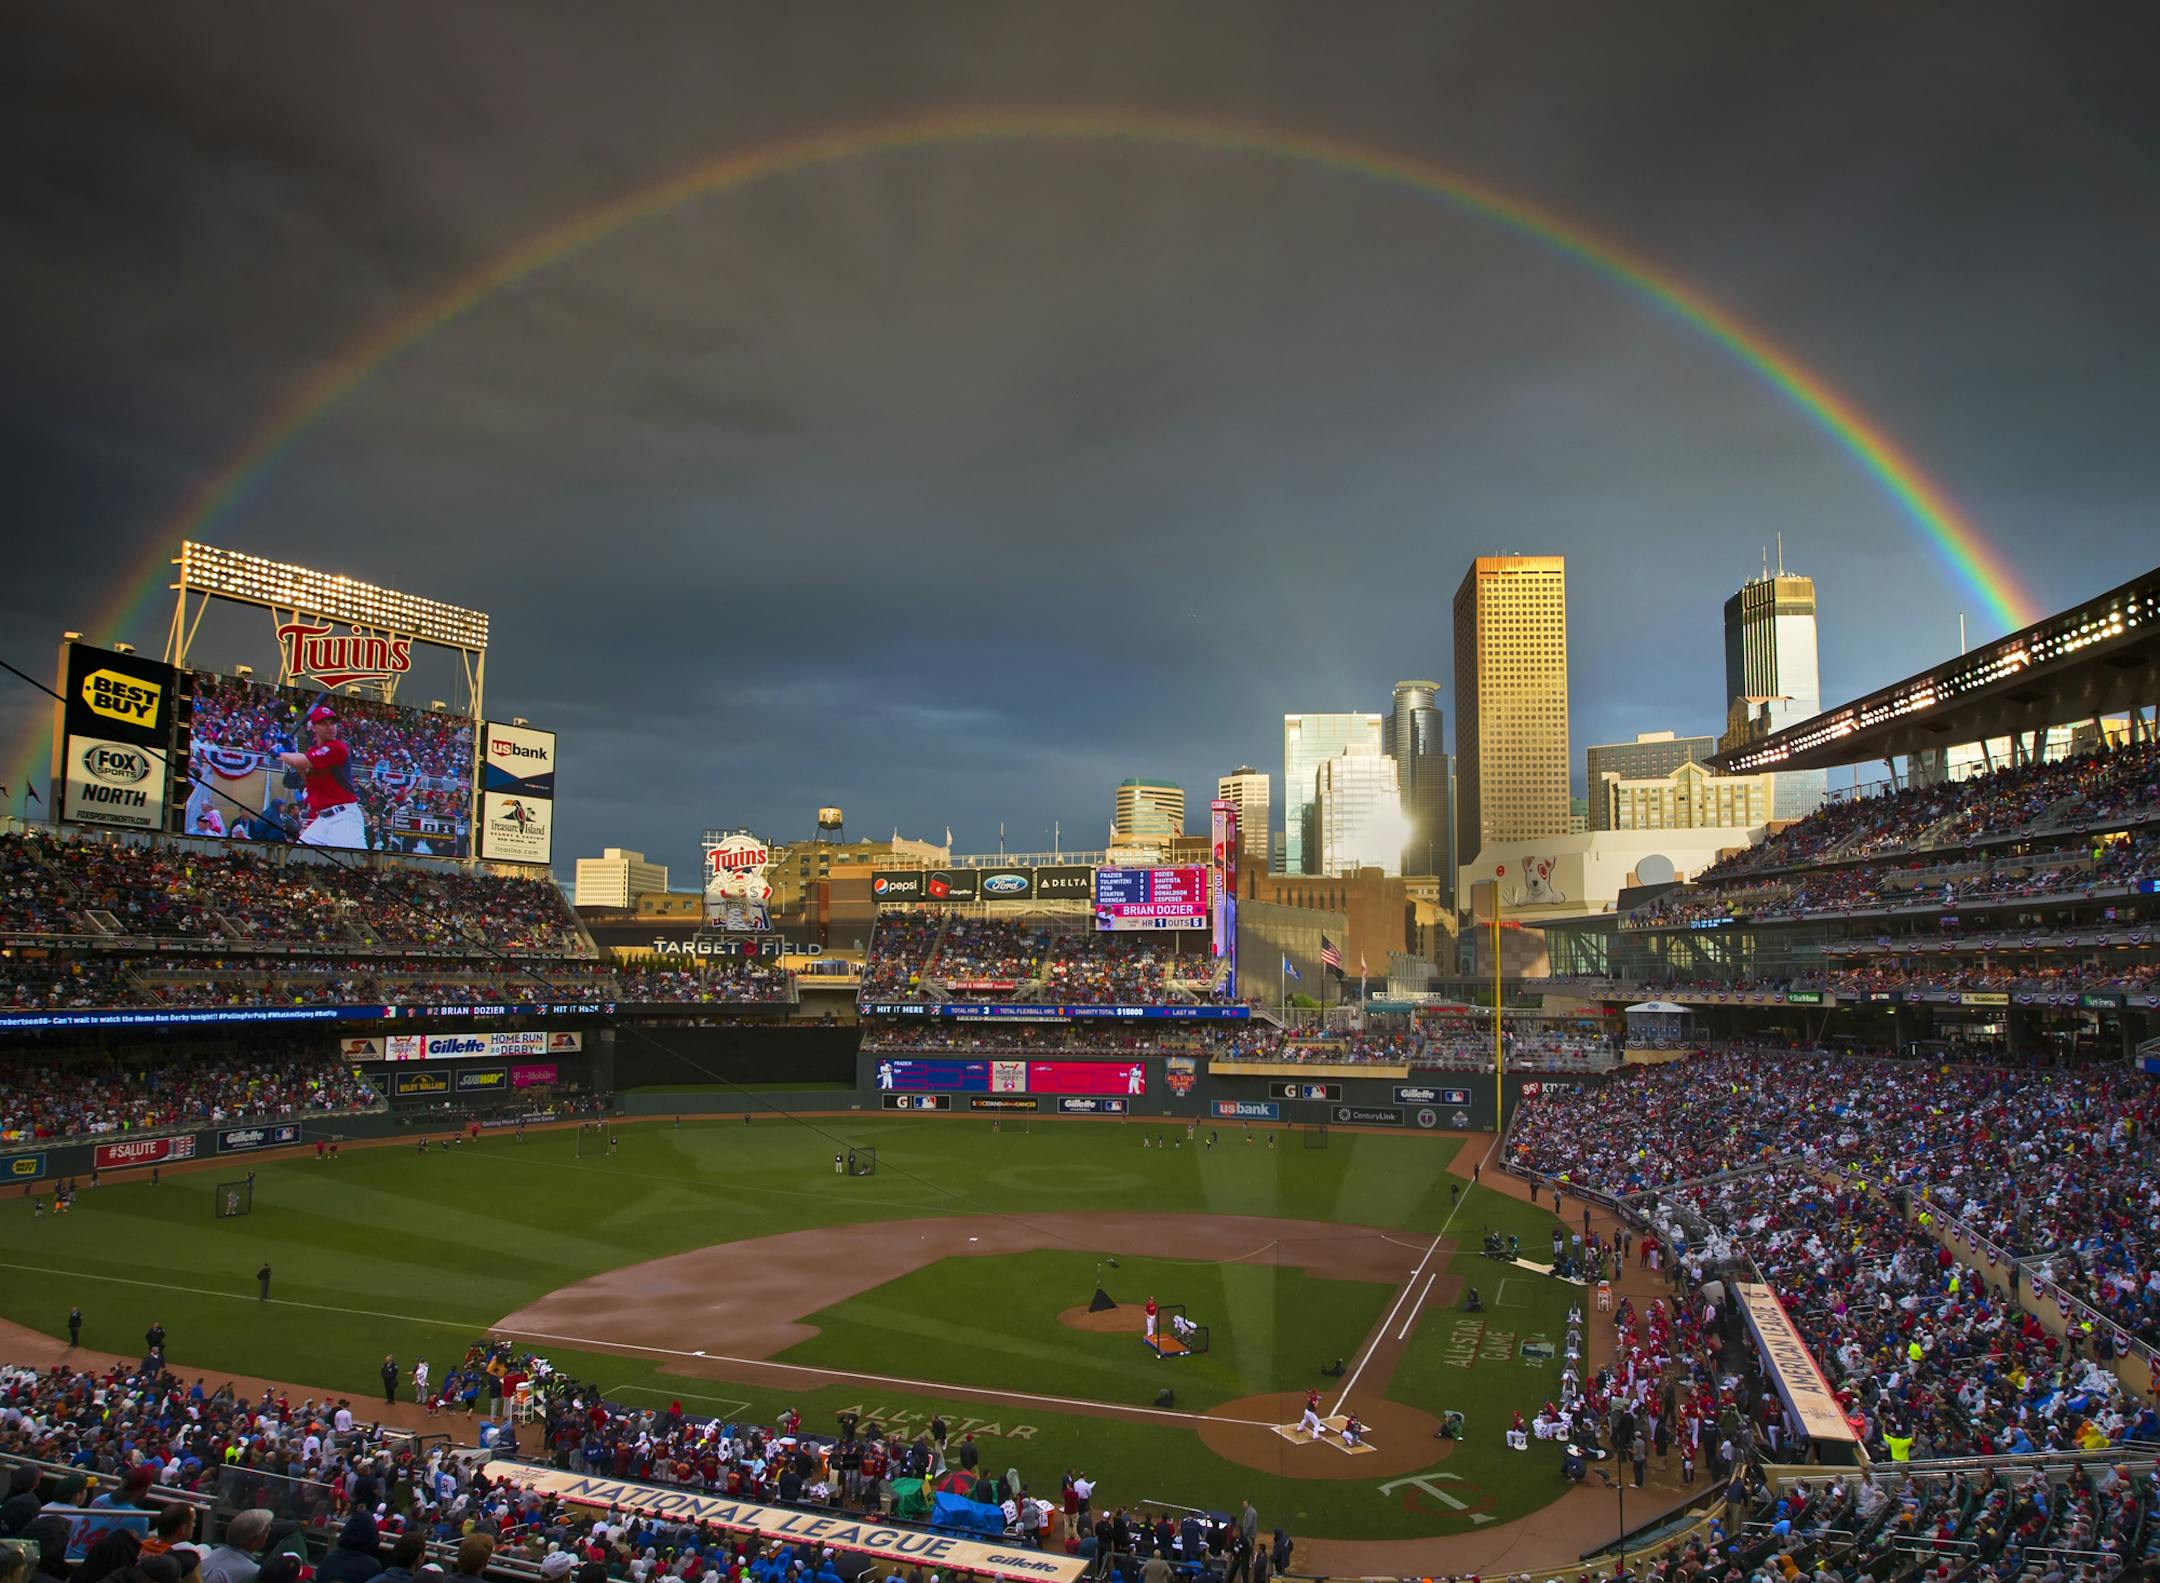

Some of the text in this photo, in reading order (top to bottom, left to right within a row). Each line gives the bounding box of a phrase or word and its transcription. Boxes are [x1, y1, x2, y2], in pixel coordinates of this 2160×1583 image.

[275, 622, 412, 677] Twins
[93, 675, 159, 706] BEST
[93, 693, 152, 719] BUY
[97, 750, 137, 772] FOX
[97, 766, 137, 779] SPORTS
[82, 783, 147, 807] NORTH
[76, 810, 151, 826] FOXSPORTSNORTH.COM
[490, 819, 546, 836] Treasure Island
[708, 847, 769, 872] Twins
[889, 879, 918, 893] pepsi
[991, 874, 1020, 890] Ford
[1052, 878, 1088, 888] DELTA
[1123, 905, 1194, 916] BRIAN DOZIER
[1193, 918, 1200, 926] 5
[653, 940, 823, 956] TARGET FIELD
[427, 1007, 439, 1016] #2
[441, 1006, 470, 1015] BRIAN
[474, 1006, 505, 1014] DOZIER
[553, 1005, 568, 1013] HIT
[876, 1006, 891, 1014] HIT
[983, 1006, 990, 1014] 3
[53, 1016, 72, 1024] Can't
[170, 1014, 190, 1022] Derby
[491, 1032, 543, 1044] HOME RUN
[428, 1038, 486, 1054] Gillette
[501, 1044, 534, 1056] DERBY
[459, 1072, 504, 1086] SUBWAY
[1284, 1085, 1296, 1098] G
[1400, 1088, 1434, 1099] Gillette
[896, 1096, 908, 1108] G
[1064, 1100, 1096, 1110] Gillette
[1352, 1112, 1396, 1122] CenturyLink
[226, 1130, 264, 1144] Gillette
[109, 1142, 156, 1158] #SALUTE
[16, 1164, 36, 1172] BUY
[1750, 1305, 1791, 1337] LEAGUE
[1442, 1319, 1486, 1369] ALL STAR
[1480, 1331, 1515, 1361] GAME
[1767, 1338, 1825, 1395] AMERICAN
[563, 1478, 1060, 1574] NATIONAL LEAGUE Gillette
